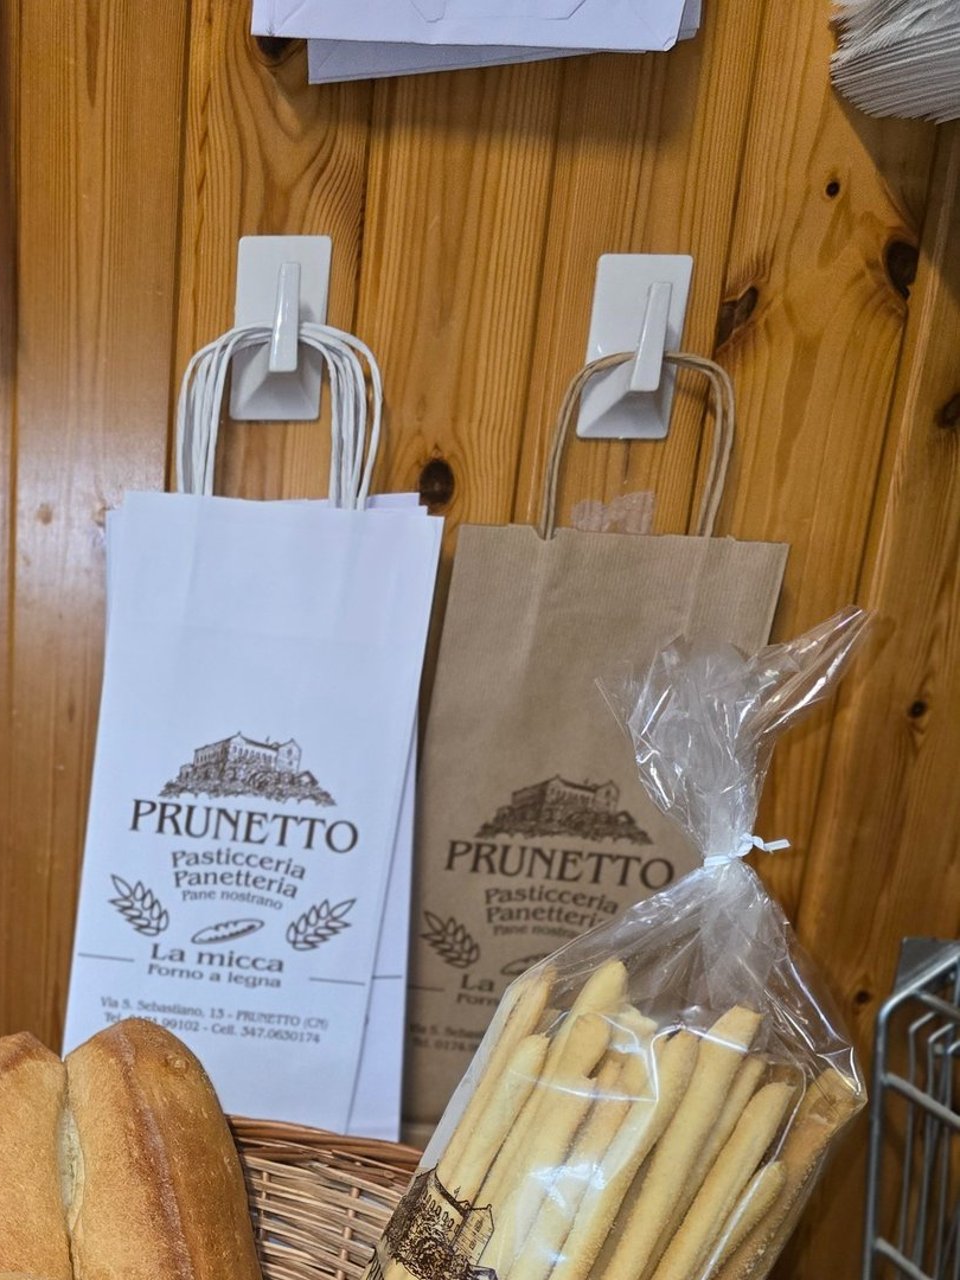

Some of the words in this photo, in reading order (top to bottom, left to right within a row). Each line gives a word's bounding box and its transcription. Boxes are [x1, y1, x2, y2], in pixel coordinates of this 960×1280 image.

[129, 799, 359, 854] PRUNETTO
[171, 849, 307, 881] Pasticceria
[444, 839, 675, 890] PRUNETTO
[174, 868, 299, 899] Panetteria
[181, 889, 217, 903] Pane
[220, 889, 283, 911] nostrano
[484, 884, 619, 916] Pasticceria
[493, 924, 528, 937] Pane
[150, 943, 186, 963] La
[197, 950, 284, 973] micca
[147, 963, 204, 981] Forno
[209, 970, 221, 983] a
[227, 972, 282, 989] legna
[461, 974, 494, 992] La
[100, 996, 119, 1009] Via
[236, 1010, 301, 1027] PRUNETTO
[456, 993, 499, 1006] Forn
[104, 1012, 122, 1024] Tel
